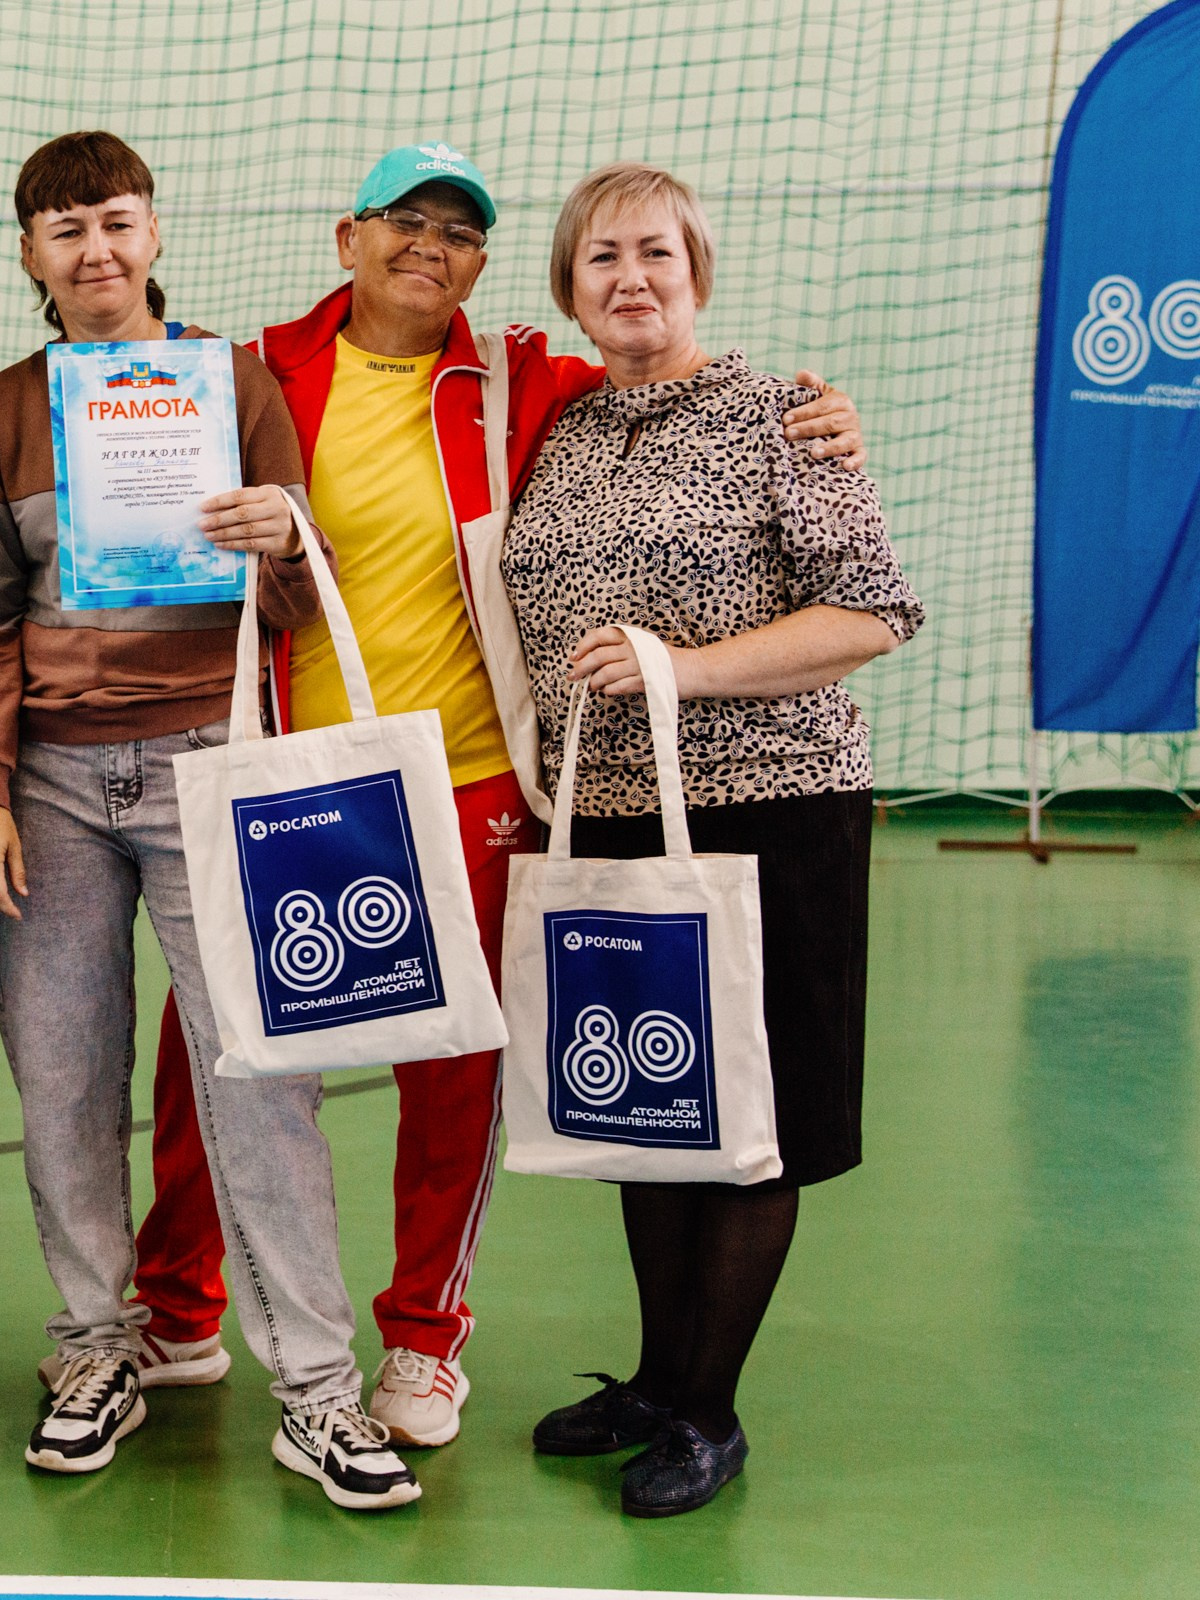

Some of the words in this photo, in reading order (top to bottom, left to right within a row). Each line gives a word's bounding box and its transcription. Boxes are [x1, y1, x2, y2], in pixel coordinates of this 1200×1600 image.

[416, 160, 465, 176] adidas
[88, 398, 199, 420] ГРАМОТА
[101, 447, 202, 460] НАГРАЖДАЕТ
[269, 809, 342, 835] РОСАТОМ
[486, 837, 518, 846] adidas
[270, 875, 412, 993] 80
[584, 935, 643, 952] РОСАТОМ
[394, 957, 421, 971] ЛЕТ
[352, 966, 424, 991] АТОМНОЙ
[280, 978, 426, 1013] ПРОМЫШЛЕННОСТИ
[562, 1004, 696, 1106] 80
[630, 1106, 701, 1119] АТОМНОЙ
[672, 1099, 700, 1109] ЛЕТ
[565, 1109, 702, 1129] ПРОМЫШЛЕННОСТИ
